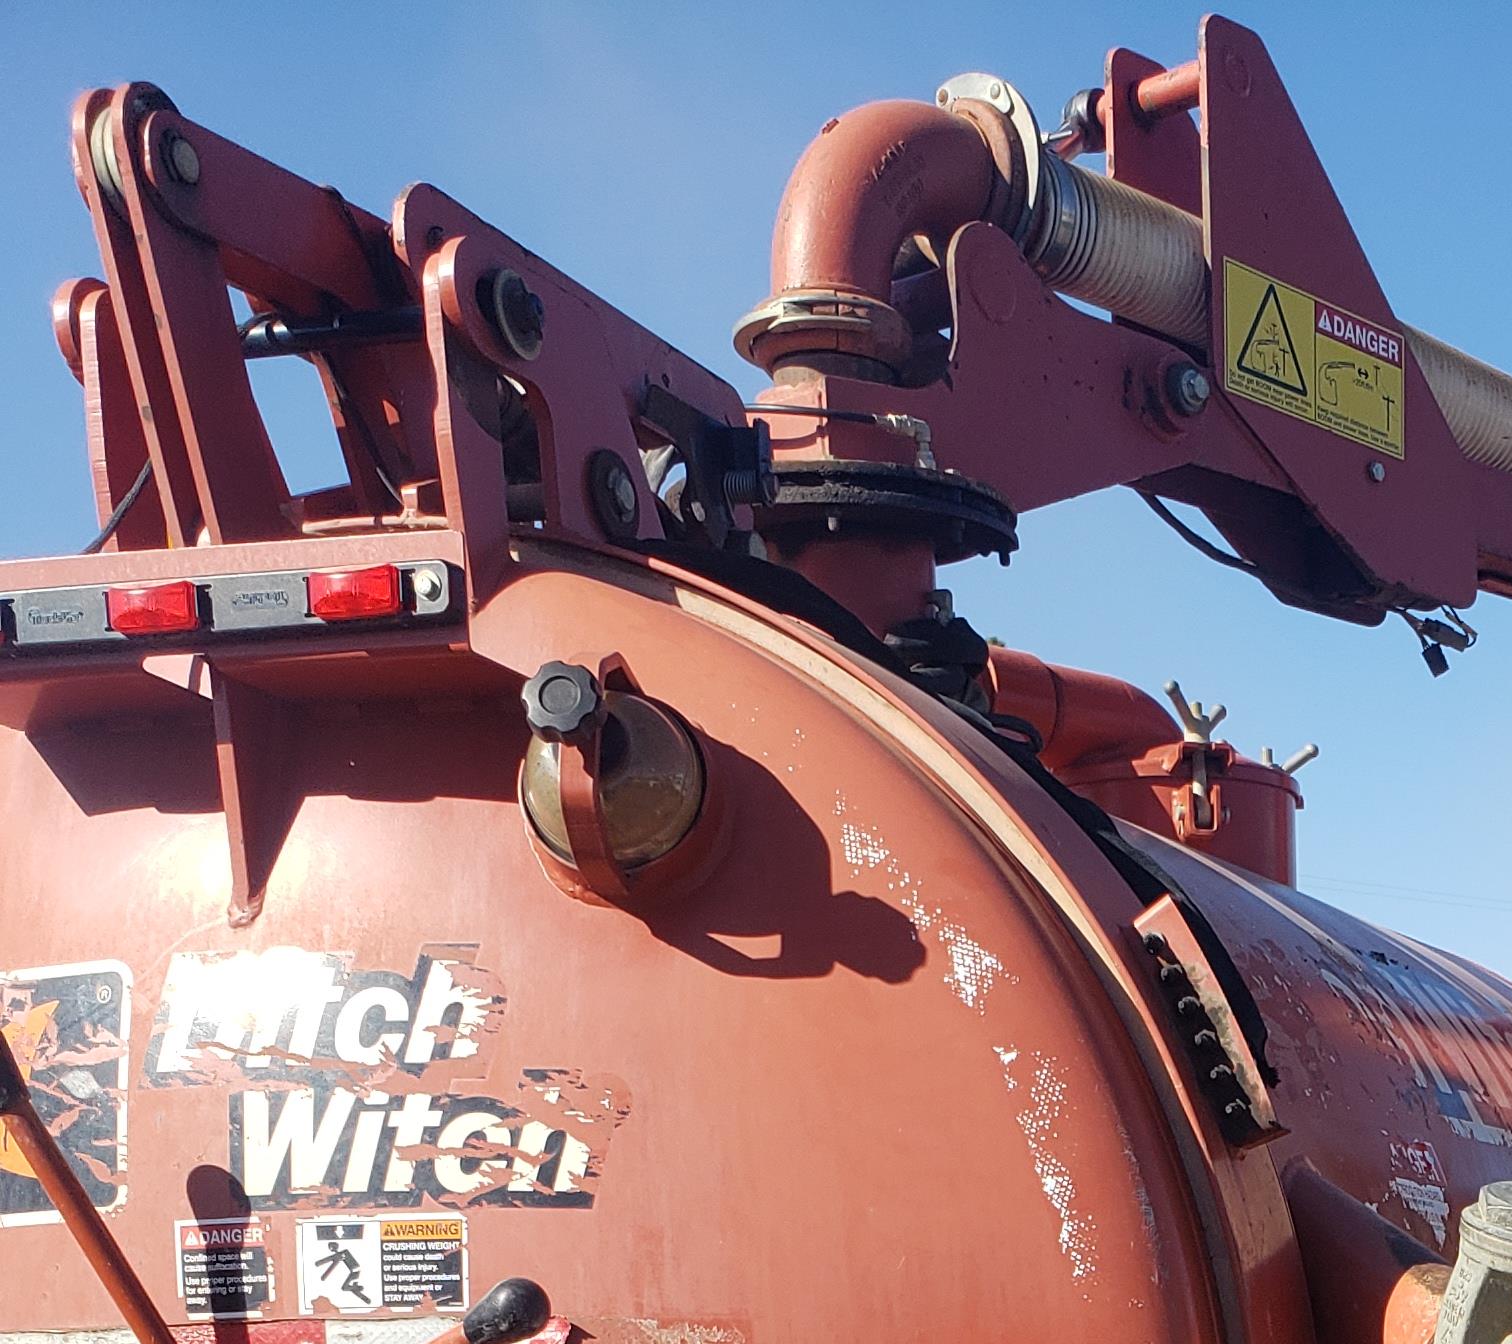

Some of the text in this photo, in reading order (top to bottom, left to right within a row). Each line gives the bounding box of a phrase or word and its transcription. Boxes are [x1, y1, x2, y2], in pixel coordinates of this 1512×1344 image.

[1333, 315, 1399, 362] DANGER
[199, 1228, 264, 1245] DANGER
[394, 1223, 459, 1236] WARNING
[382, 1241, 460, 1251] CRUSHING WEIGHT
